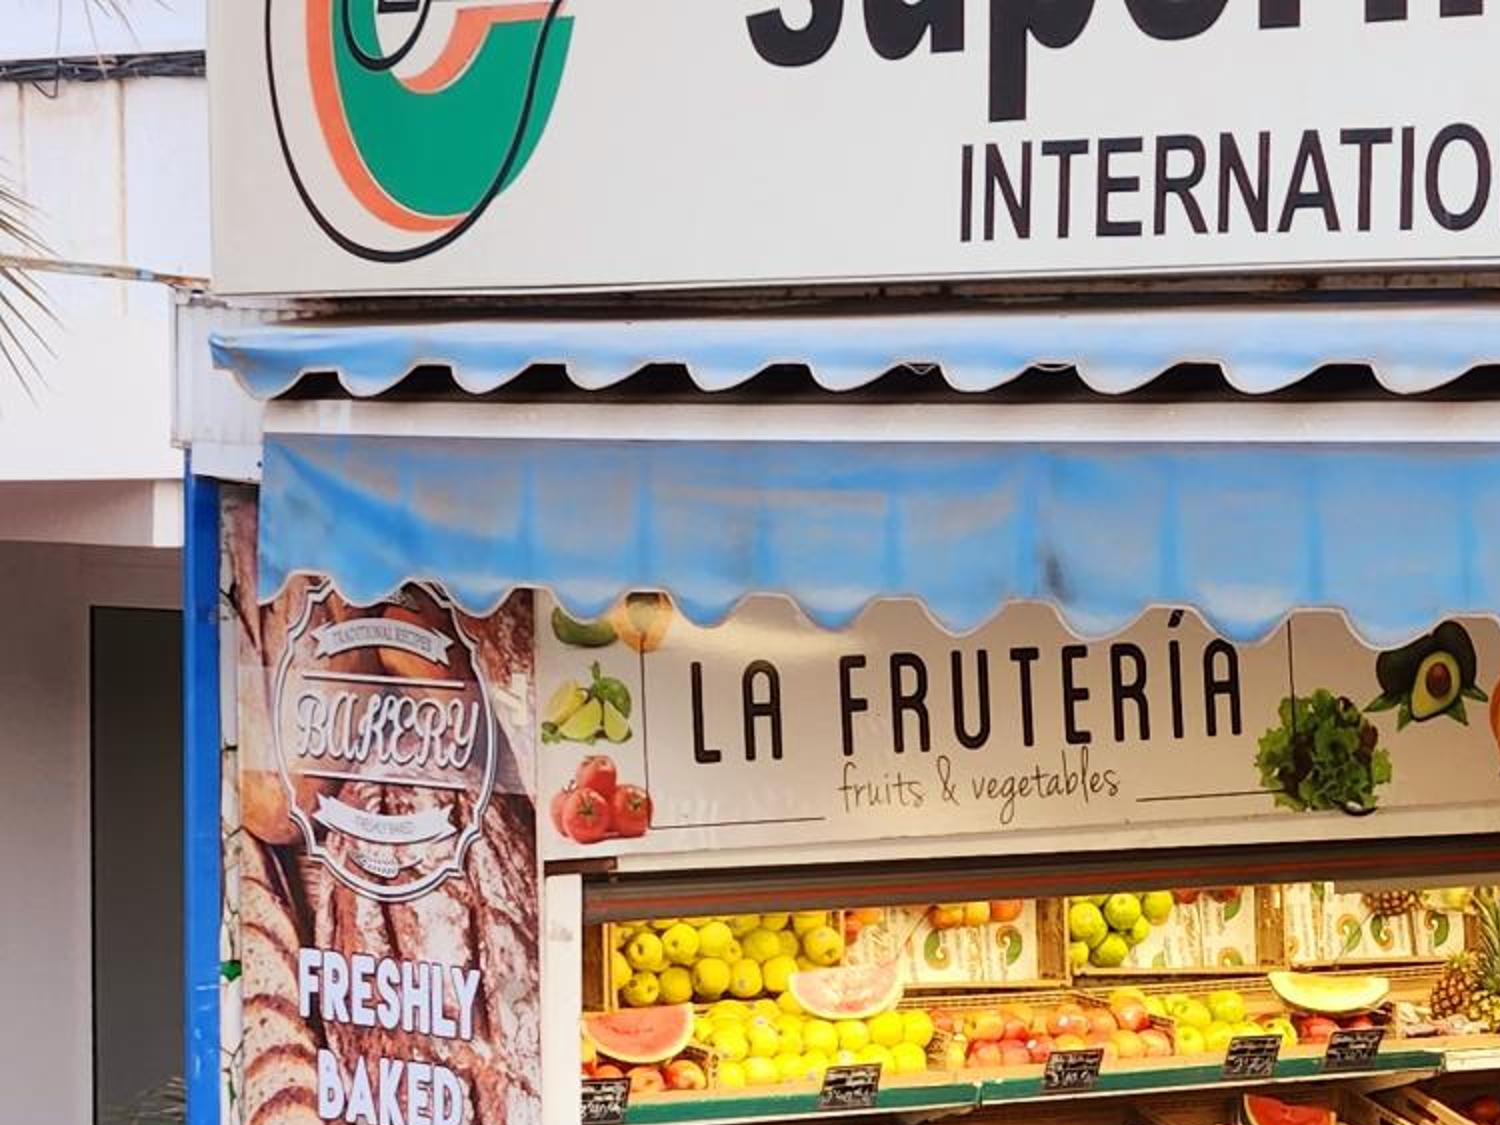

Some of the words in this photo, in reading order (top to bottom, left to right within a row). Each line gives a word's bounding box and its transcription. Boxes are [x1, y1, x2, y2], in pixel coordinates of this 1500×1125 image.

[689, 660, 783, 764] LA
[838, 609, 1243, 757] FRUTERÍA
[299, 692, 480, 769] BAKERY
[838, 761, 925, 812] fruits
[937, 755, 961, 808] &
[972, 745, 1121, 824] vegetables
[299, 947, 481, 1042] FRESHLY
